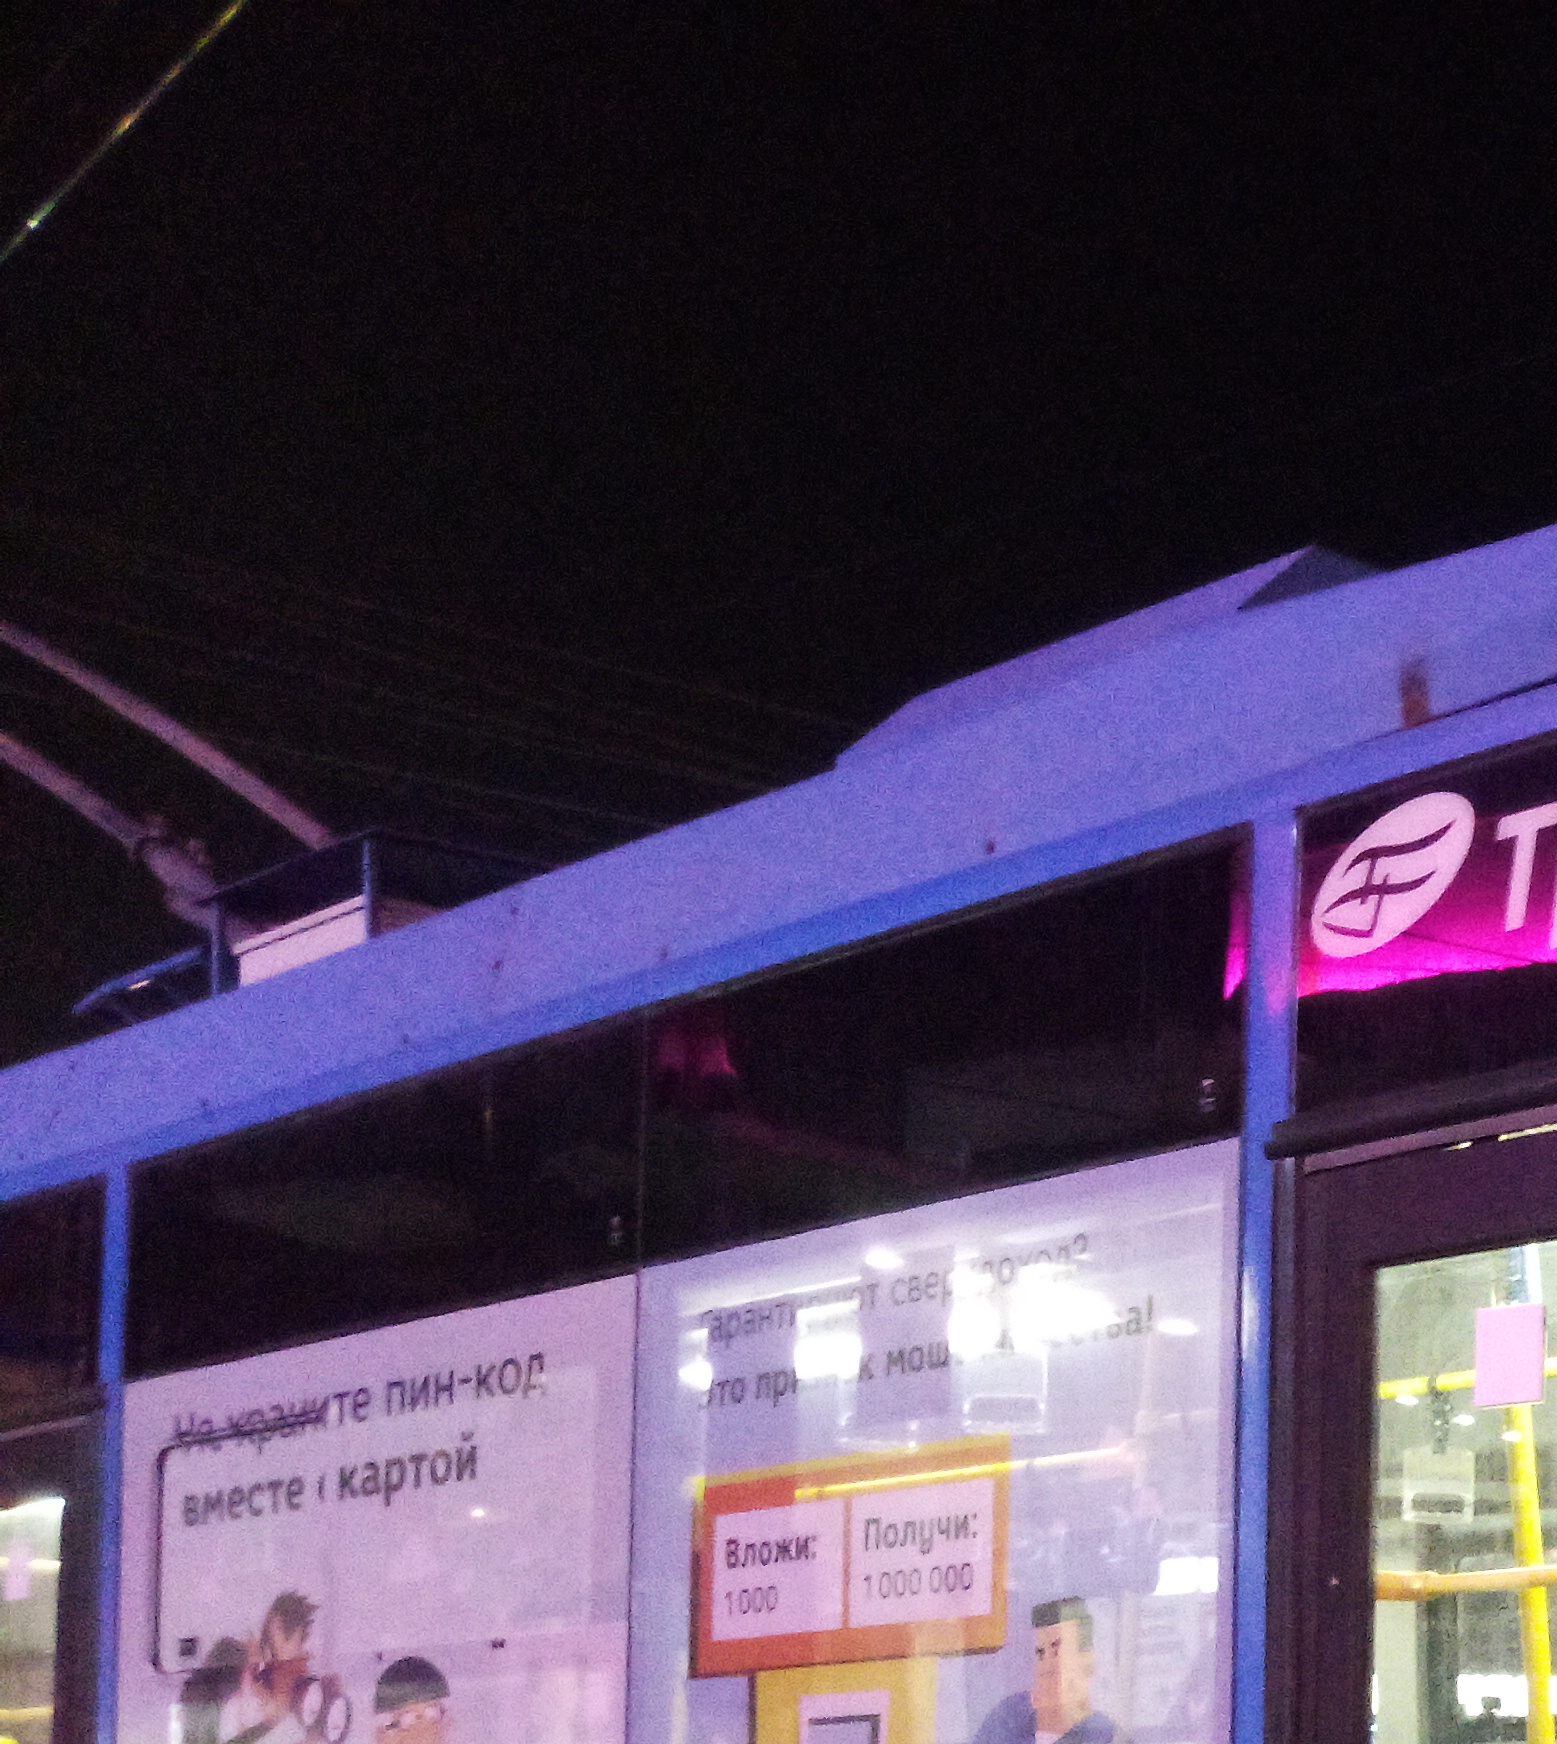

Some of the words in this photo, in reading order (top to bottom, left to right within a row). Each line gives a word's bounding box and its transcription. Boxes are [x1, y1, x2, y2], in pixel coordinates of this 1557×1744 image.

[182, 1478, 304, 1527] вместе
[337, 1432, 479, 1506] картой
[724, 1536, 818, 1569] Вложи:
[864, 1513, 979, 1555] Получи:
